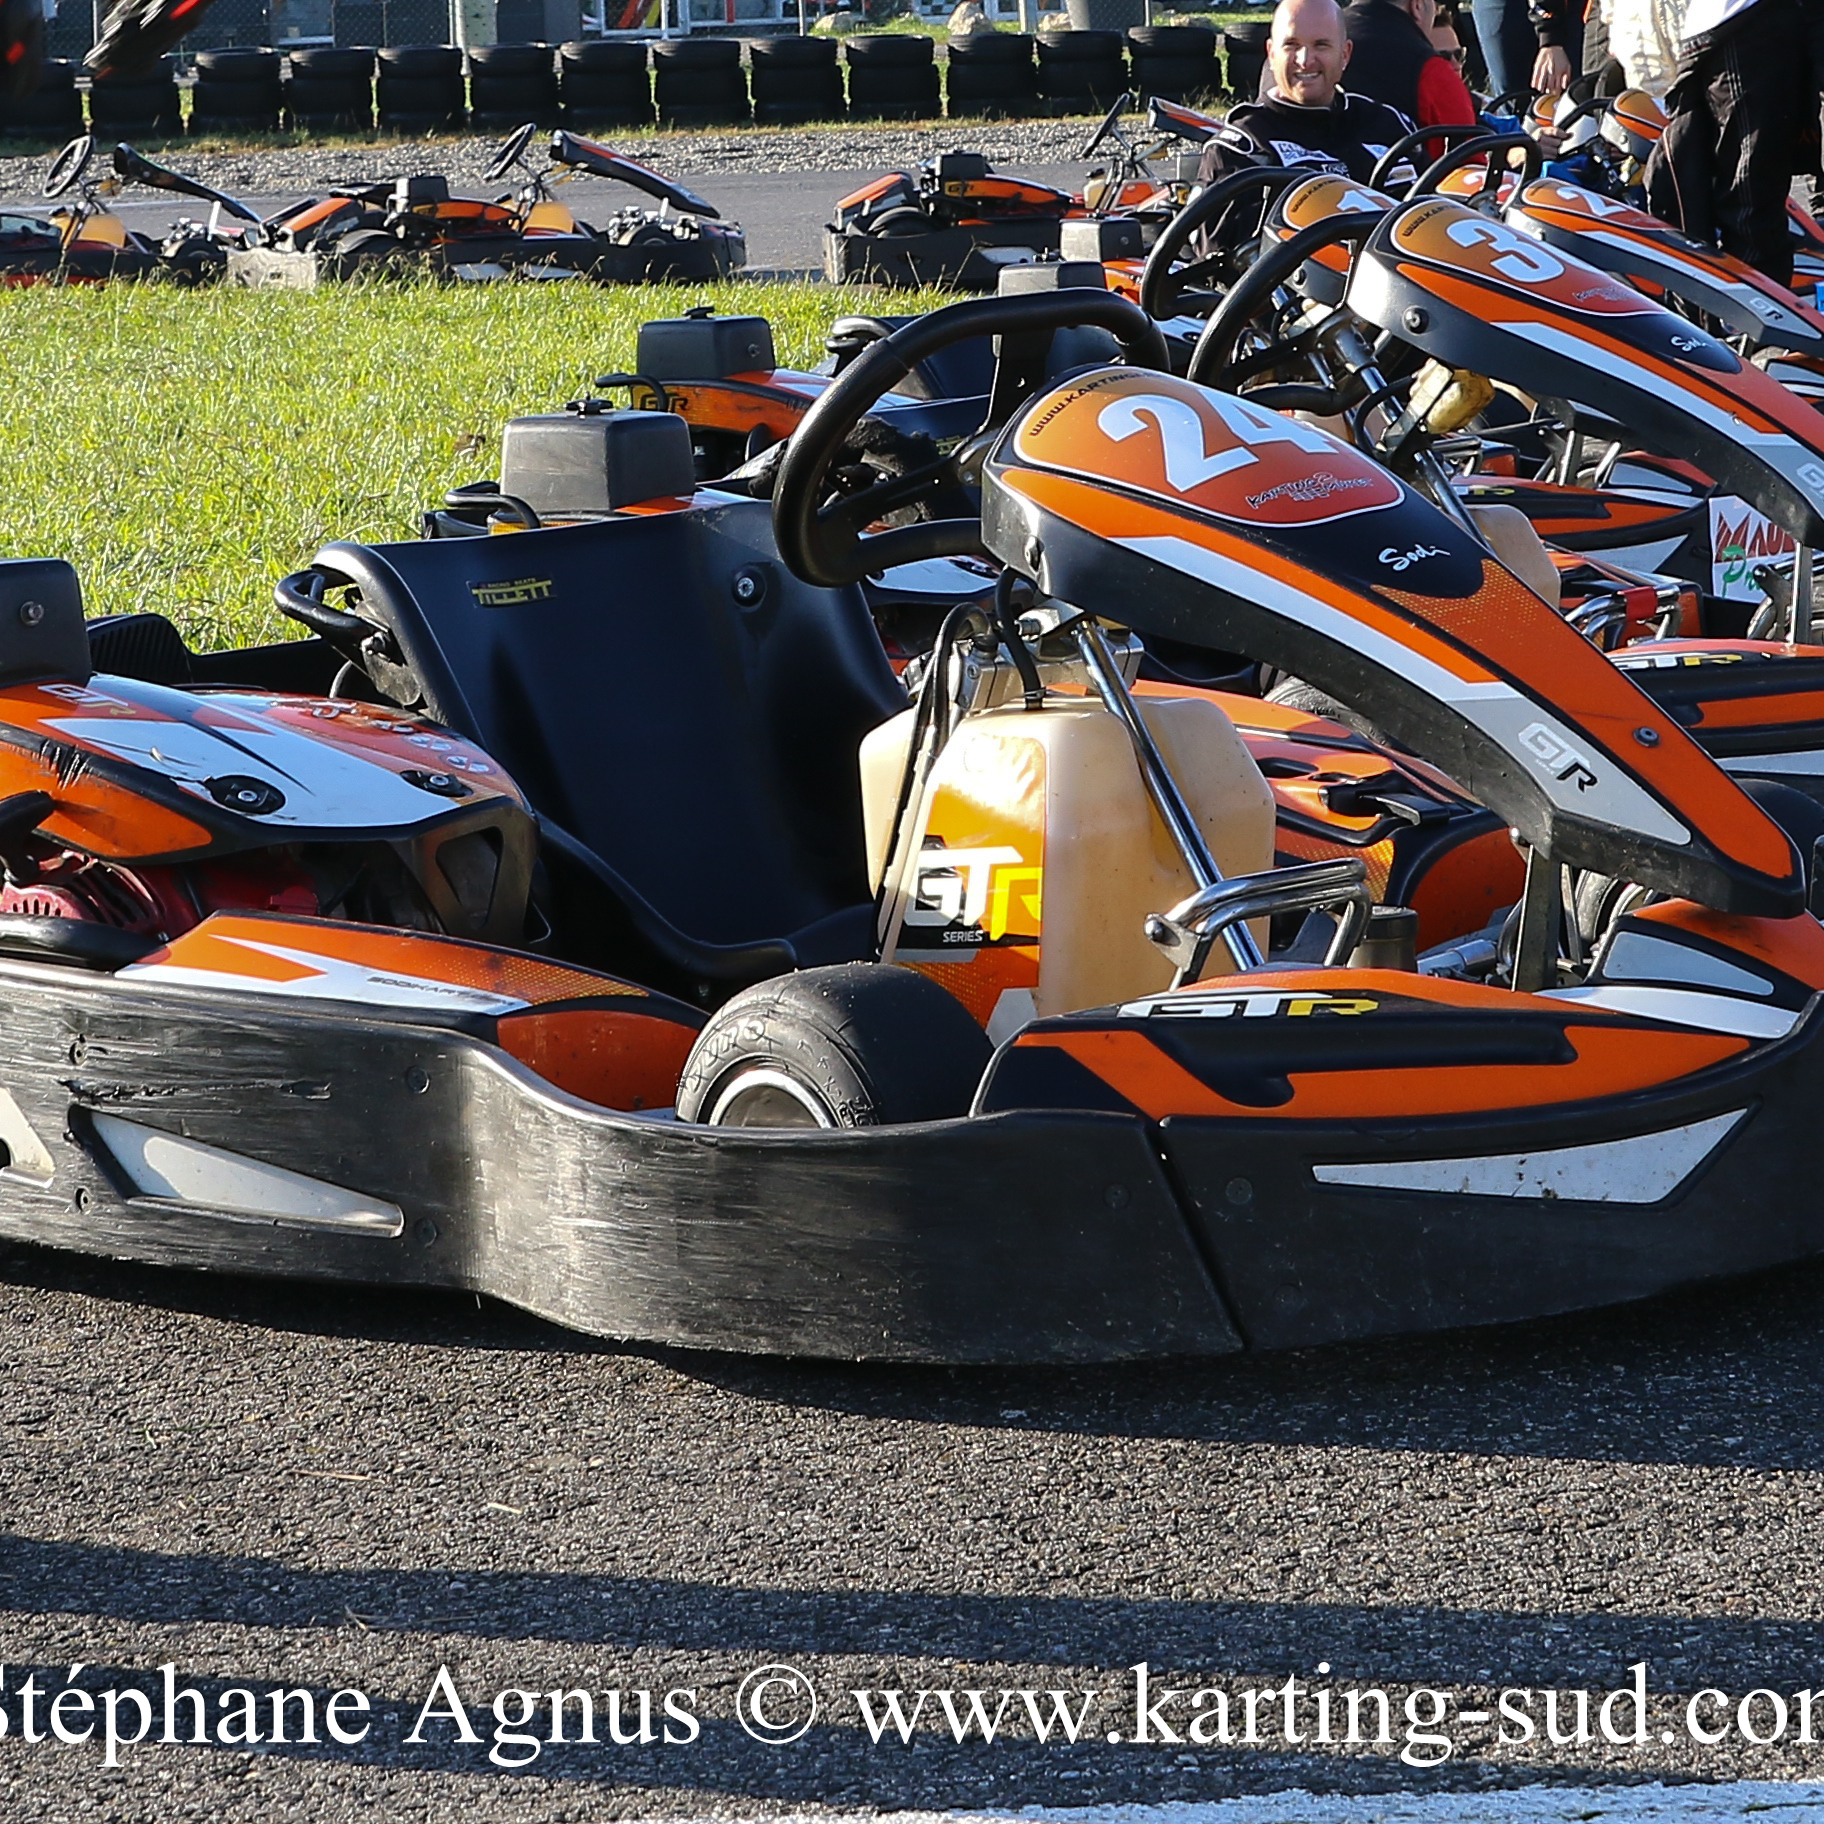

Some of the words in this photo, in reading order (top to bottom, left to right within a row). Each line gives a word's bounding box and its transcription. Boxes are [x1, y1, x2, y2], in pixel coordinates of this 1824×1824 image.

[1749, 297, 1783, 321] GTR
[1097, 387, 1339, 493] 24
[1245, 477, 1318, 511] KARTING
[1379, 543, 1451, 571] Sodi
[472, 580, 553, 605] TILLETT
[1518, 722, 1599, 794] GTR
[903, 845, 1043, 942] GTR
[942, 930, 985, 943] SERIES
[1116, 985, 1379, 1021] GTR
